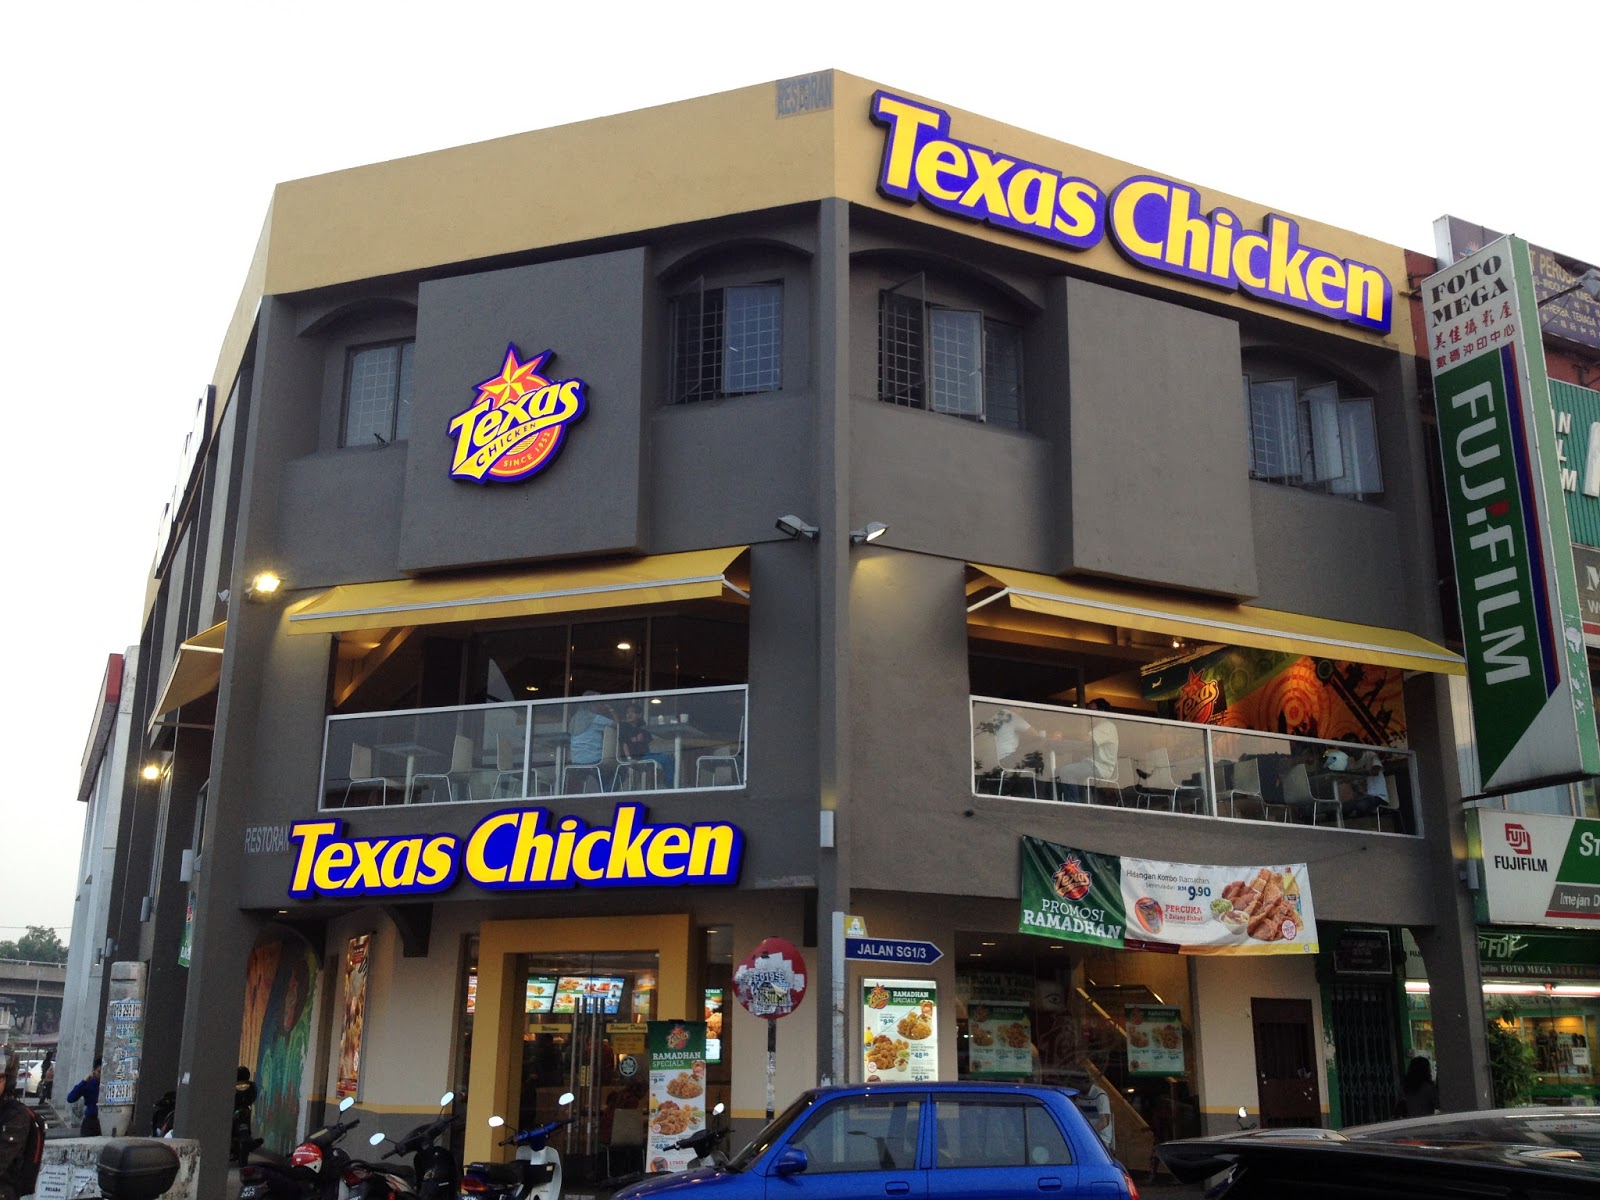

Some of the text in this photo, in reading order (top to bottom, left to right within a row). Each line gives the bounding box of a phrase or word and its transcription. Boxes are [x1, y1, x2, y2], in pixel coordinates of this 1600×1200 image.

[879, 97, 1385, 322] Texas Chicken
[1431, 255, 1502, 304] FOTO
[1432, 276, 1509, 328] MEGA
[449, 381, 580, 472] Texas
[476, 422, 537, 467] CHICKEN
[503, 432, 551, 467] SINCE 1952
[1451, 380, 1531, 686] FUJIFILM
[291, 806, 733, 892] Texas Chicken
[1495, 855, 1548, 873] FUJIFILM
[1157, 873, 1178, 883] Kombo
[1187, 885, 1211, 901] 9.90
[1559, 892, 1591, 909] Imejan
[1042, 898, 1105, 923] PROMOSI
[1165, 904, 1202, 914] PERCUMA
[1023, 909, 1122, 940] RAMADHAN
[857, 943, 927, 959] JALAN SG1/3
[1500, 964, 1525, 973] FOTO
[1527, 965, 1553, 974] MEGA
[892, 990, 930, 998] RAMADHAN
[652, 1052, 701, 1061] RAMADHAN
[652, 1060, 685, 1068] SPECIALS
